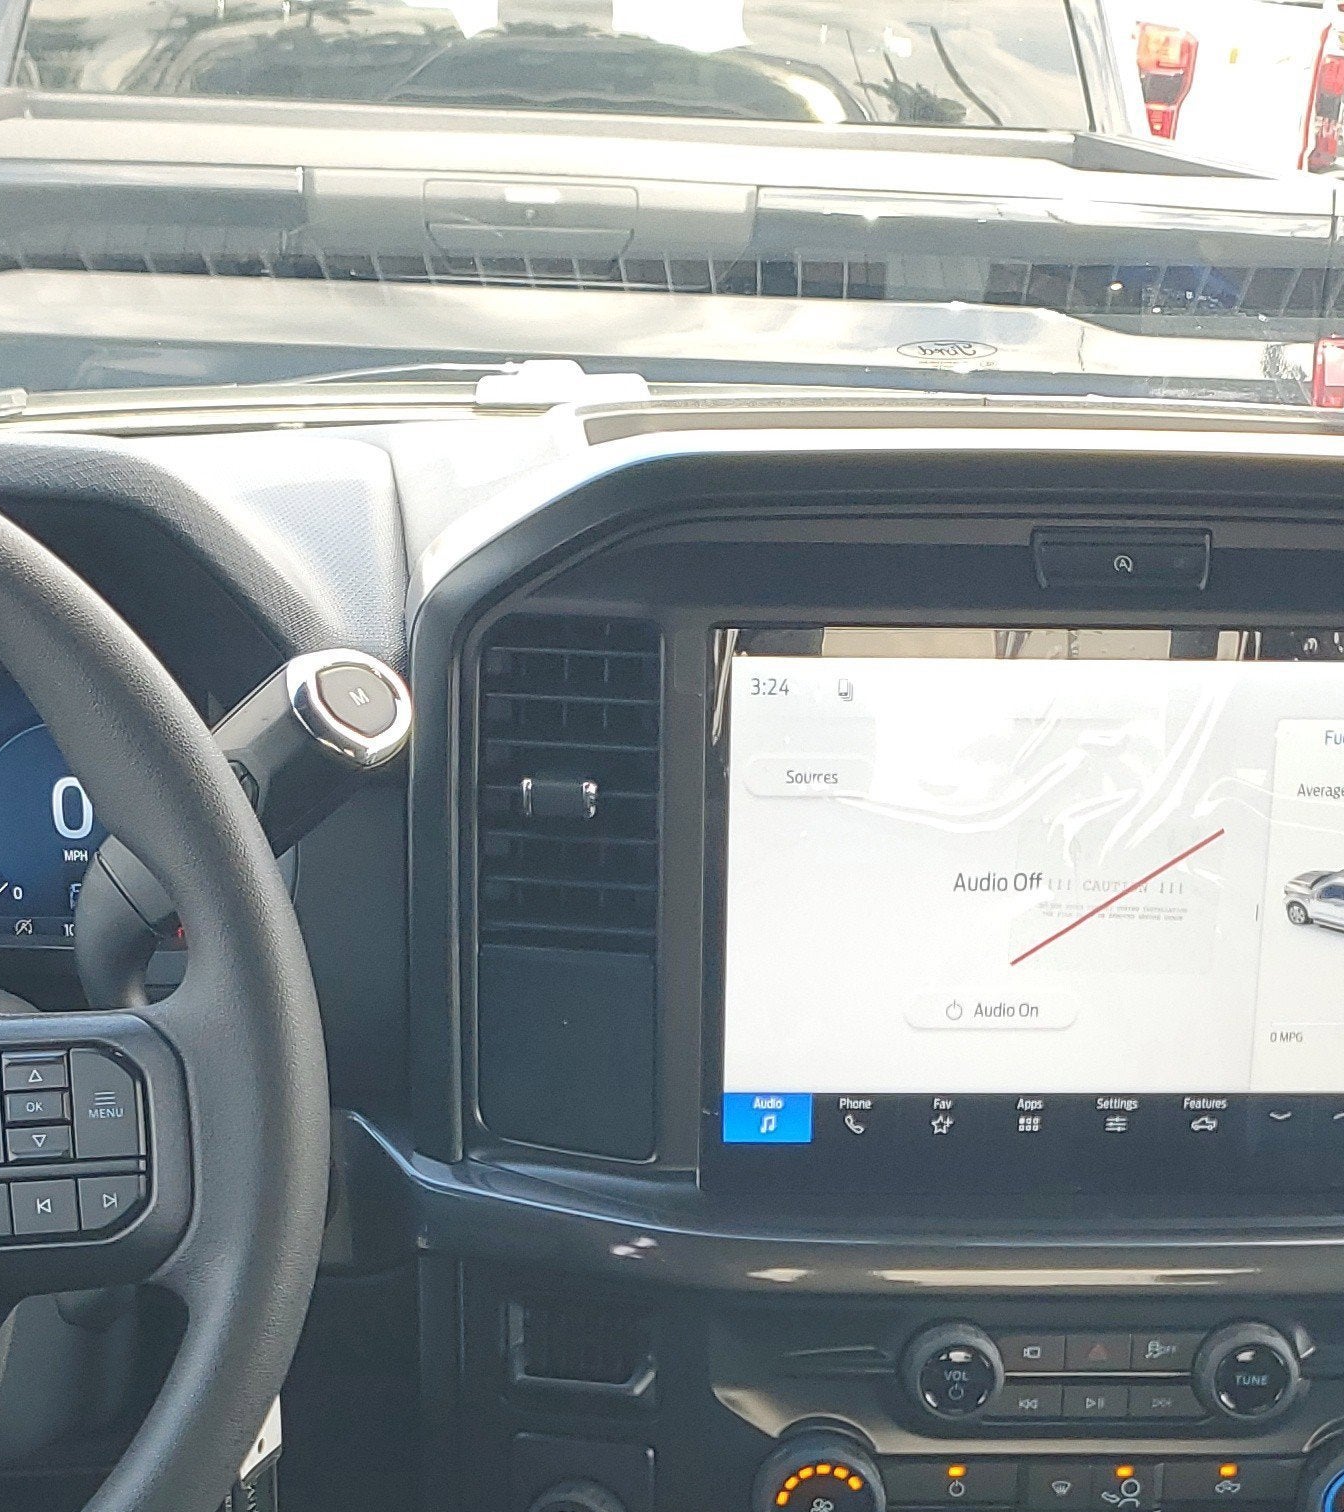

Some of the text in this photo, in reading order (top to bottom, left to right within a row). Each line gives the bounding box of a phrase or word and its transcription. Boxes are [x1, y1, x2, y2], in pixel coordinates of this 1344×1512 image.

[750, 678, 790, 696] 3:24
[349, 687, 370, 706] M
[786, 769, 839, 785] Sources
[52, 776, 94, 840] 0
[64, 850, 89, 862] MPH
[953, 872, 1043, 892] Audio Off
[1082, 879, 1149, 893] CAUTIN
[13, 887, 23, 900] 0
[974, 1002, 1039, 1018] Audio On
[1270, 1032, 1303, 1043] 0 MPG
[26, 1101, 43, 1112] OK
[753, 1098, 783, 1110] Audio
[839, 1098, 872, 1110] Phone
[933, 1098, 952, 1110] Fav
[1017, 1098, 1043, 1111] Apps
[1096, 1098, 1139, 1111] Settings
[1183, 1098, 1227, 1110] Features
[88, 1108, 124, 1119] MENU
[944, 1370, 969, 1381] VOL
[1236, 1375, 1269, 1386] TUNE
